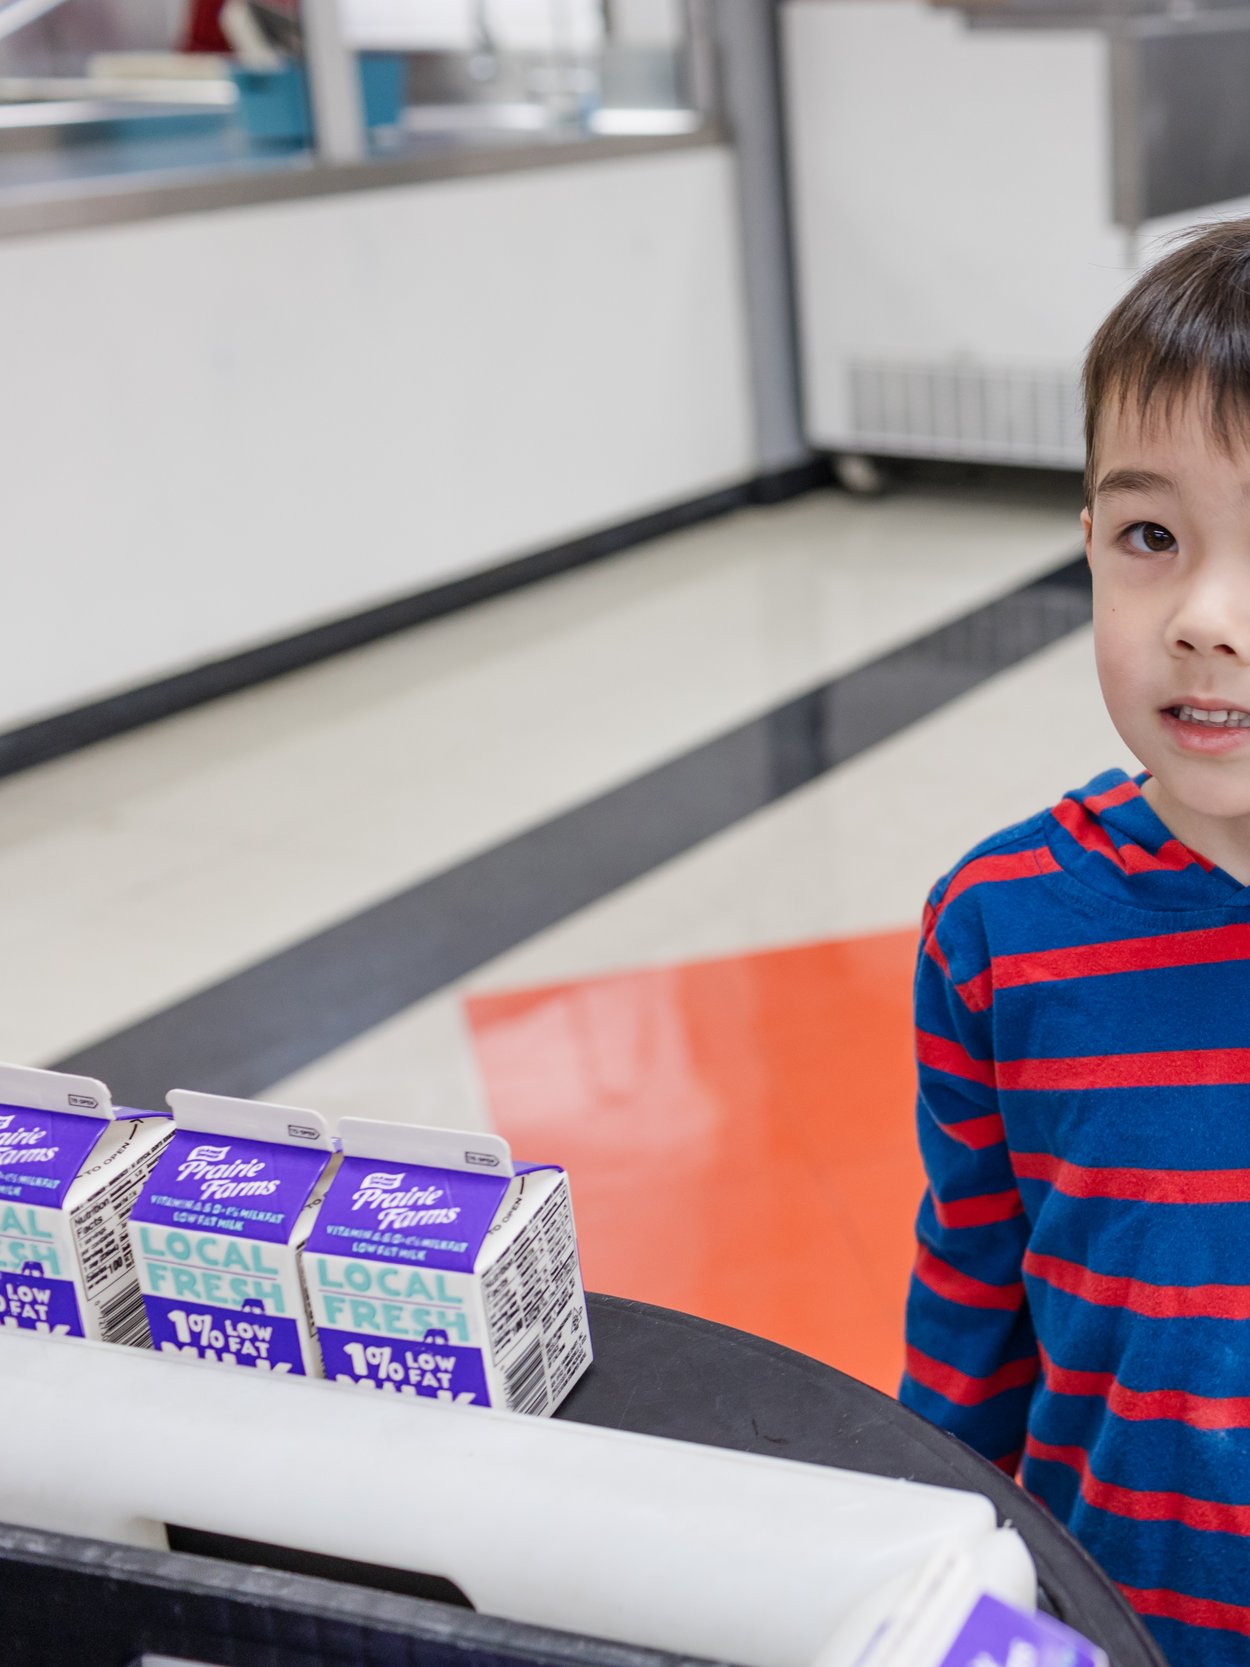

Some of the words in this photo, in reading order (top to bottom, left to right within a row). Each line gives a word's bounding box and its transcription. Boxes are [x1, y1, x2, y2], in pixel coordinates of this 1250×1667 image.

[86, 1165, 101, 1175] TO
[104, 1142, 130, 1165] OPEN
[176, 1159, 266, 1182] Prairie
[200, 1179, 281, 1201] Farms
[351, 1186, 444, 1211] Prairie
[173, 1211, 196, 1223] LOW
[197, 1215, 218, 1227] FAT
[217, 1219, 245, 1231] MILK
[377, 1207, 462, 1230] Farms
[502, 1197, 522, 1222] OPEN
[140, 1227, 279, 1276] LOCAL
[352, 1241, 377, 1253] LOW
[377, 1245, 398, 1257] FAT
[398, 1249, 427, 1262] MILK
[146, 1262, 286, 1314] FRESH
[317, 1258, 464, 1304] LOCAL
[6, 1283, 51, 1304] LOW
[9, 1300, 49, 1321] FAT
[322, 1294, 470, 1342] FRESH
[167, 1310, 225, 1348] 1%
[224, 1319, 273, 1342] LOW
[228, 1336, 270, 1358] FAT
[343, 1342, 404, 1381] 1%
[405, 1351, 456, 1372] LOW
[408, 1369, 452, 1389] FAT
